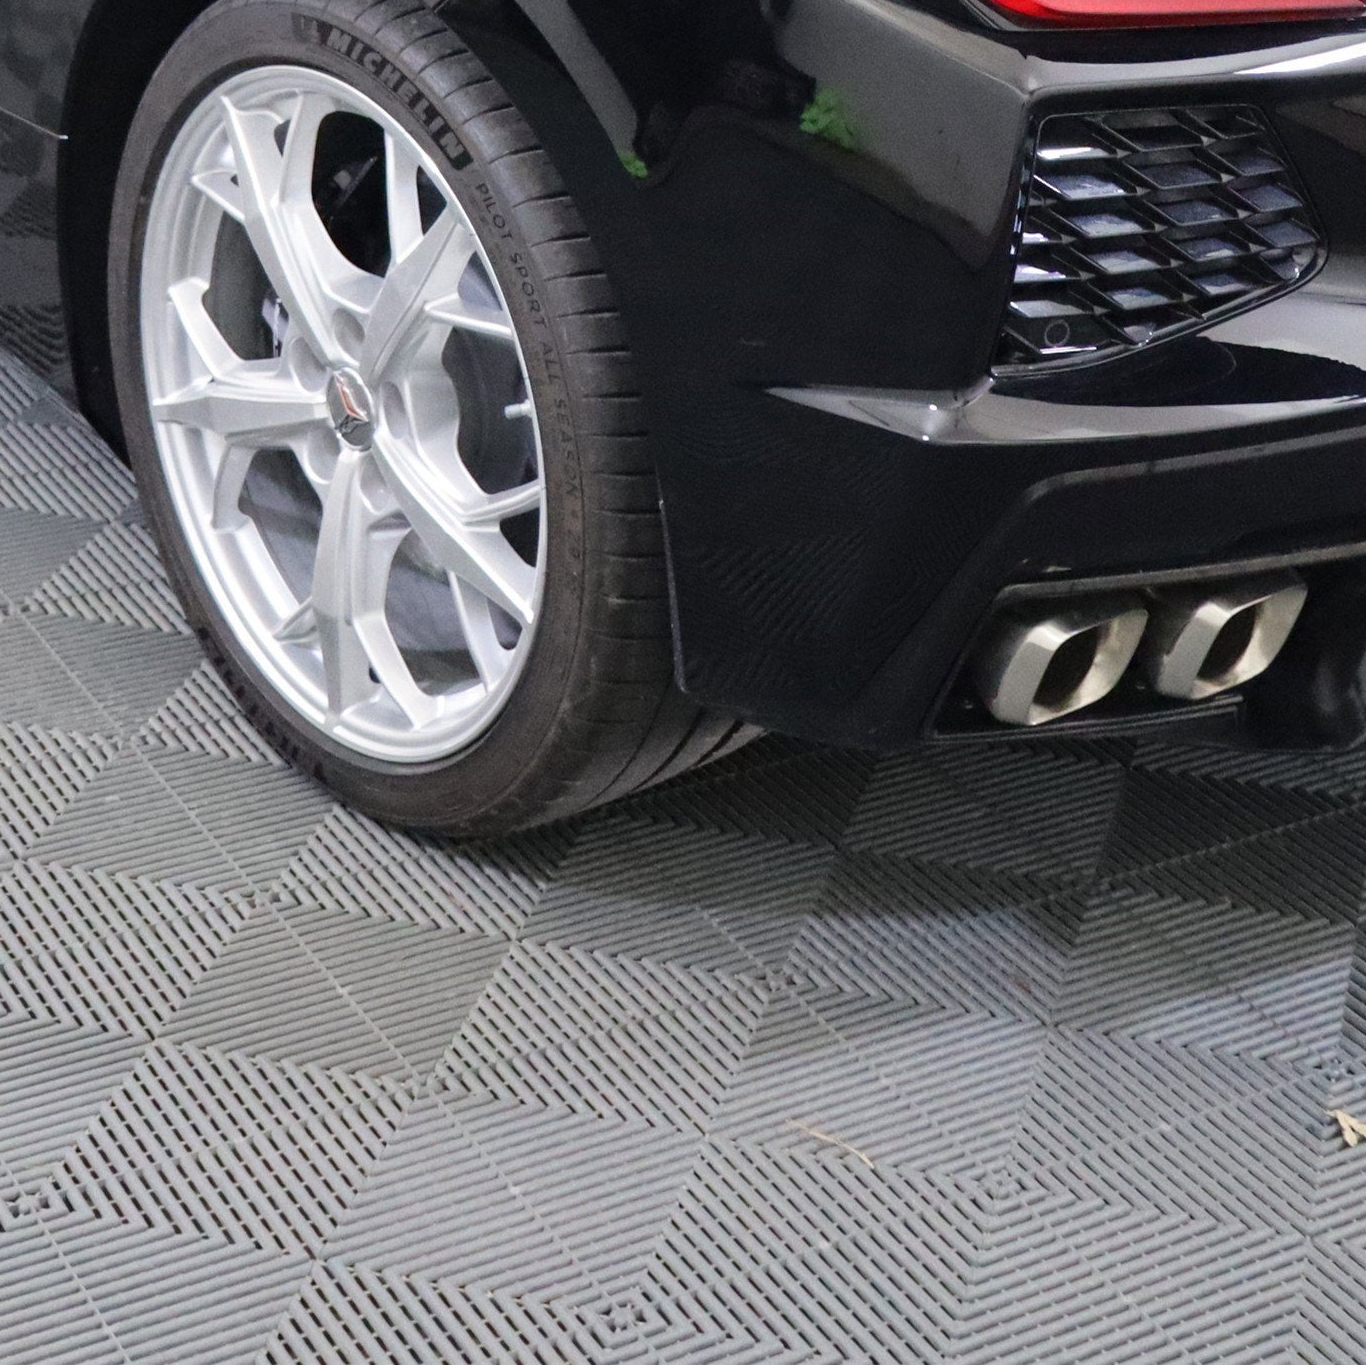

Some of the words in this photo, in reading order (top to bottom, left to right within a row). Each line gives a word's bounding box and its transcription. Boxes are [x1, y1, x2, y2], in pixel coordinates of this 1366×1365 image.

[325, 28, 467, 160] MICHELIN
[475, 183, 513, 241] PILOT
[509, 252, 548, 329] SPORT
[539, 340, 561, 386] ALL
